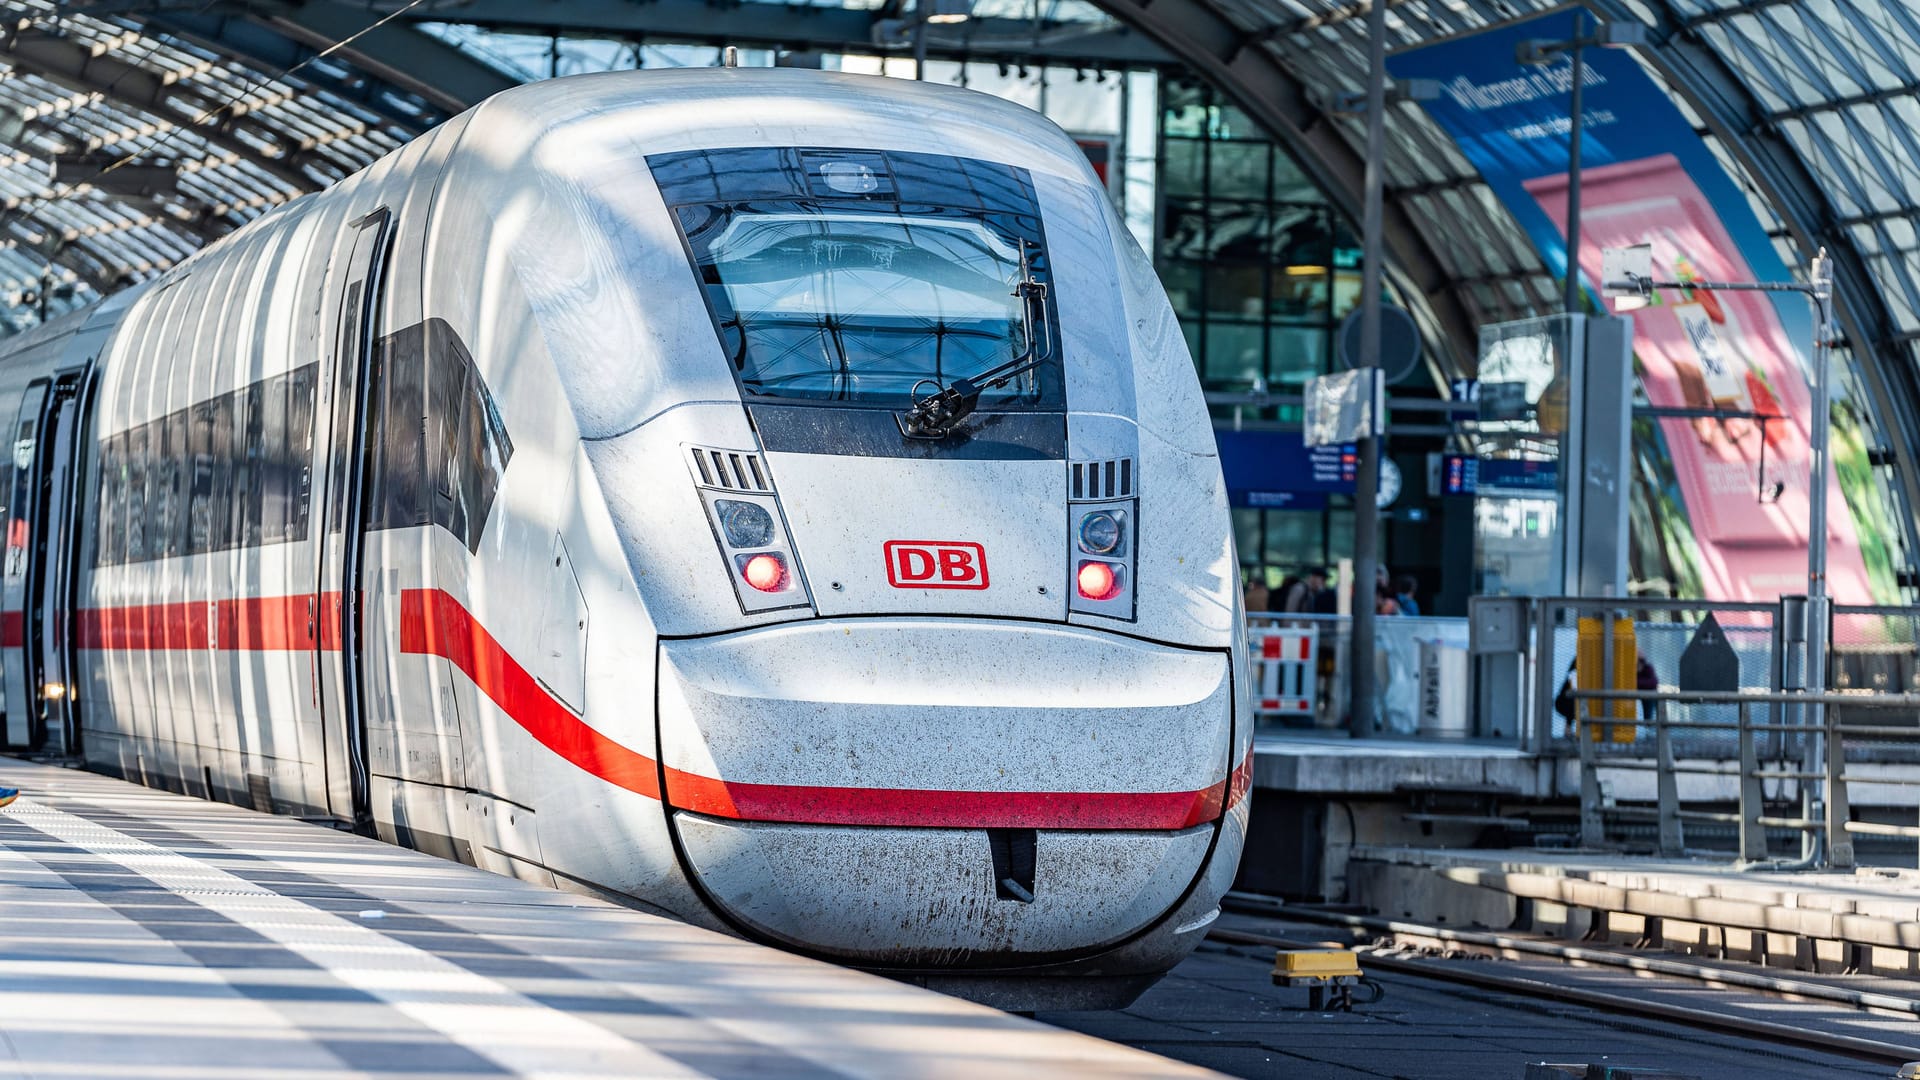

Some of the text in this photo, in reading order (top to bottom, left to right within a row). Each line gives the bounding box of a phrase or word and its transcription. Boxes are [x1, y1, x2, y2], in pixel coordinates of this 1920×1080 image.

[1440, 76, 1541, 112] Willkommen
[1521, 65, 1556, 97] in
[896, 547, 977, 582] DB
[1425, 666, 1440, 719] Abfall
